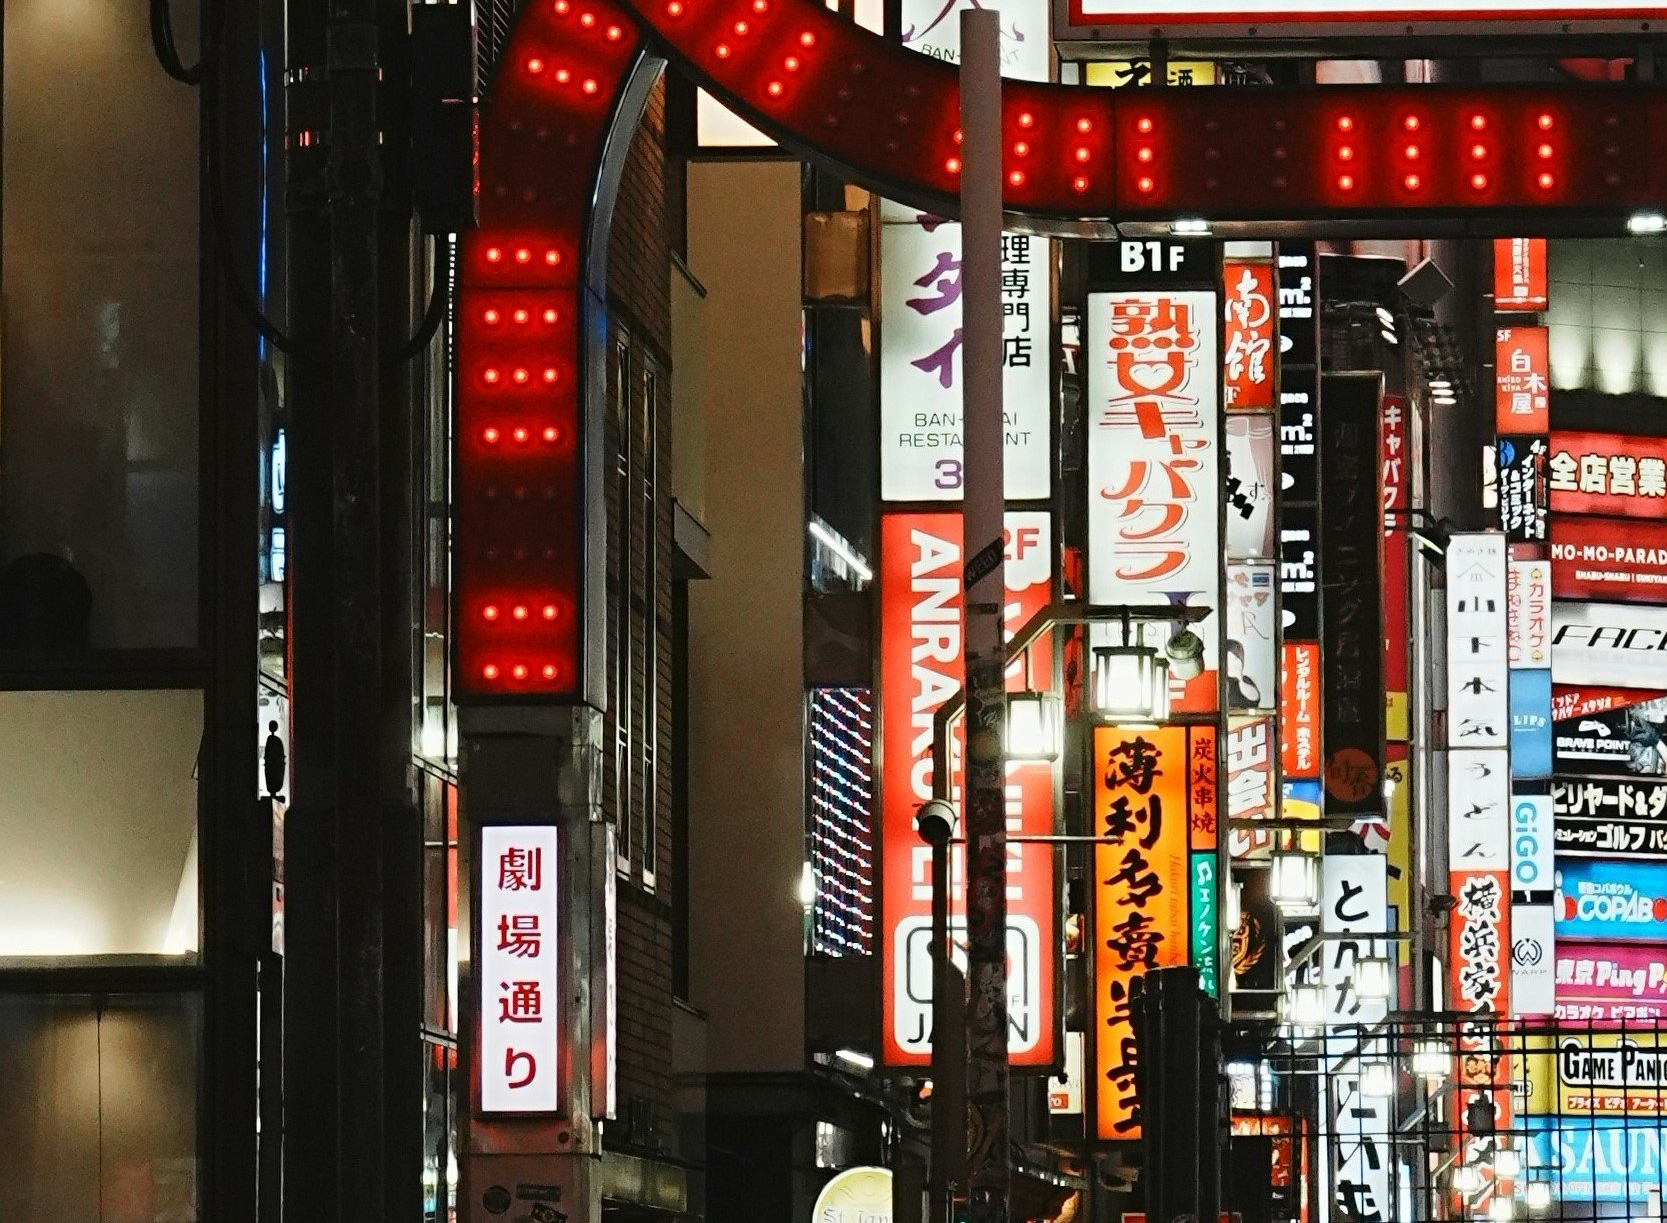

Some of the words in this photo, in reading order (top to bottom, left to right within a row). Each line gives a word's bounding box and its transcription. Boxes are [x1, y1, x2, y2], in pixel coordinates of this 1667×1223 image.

[1120, 241, 1185, 272] B1F
[1510, 348, 1548, 415] 白木屋
[899, 431, 1032, 448] RESTANT
[914, 412, 1018, 428] BAN-AI
[1099, 297, 1211, 582] 熟女キャバクラ
[1528, 582, 1544, 648] カラオケ
[1295, 646, 1312, 723] レンタルルーム
[1513, 714, 1547, 728] LIPS
[1295, 727, 1312, 771] ホステル
[1556, 736, 1595, 750] BRAVE
[1596, 738, 1631, 752] POINT
[1515, 802, 1539, 884] GiGO
[1596, 823, 1647, 851] ゴルフ
[497, 846, 542, 1090] 劇場通り
[1554, 1004, 1605, 1019] カラオケ
[1563, 1042, 1615, 1081] GAME
